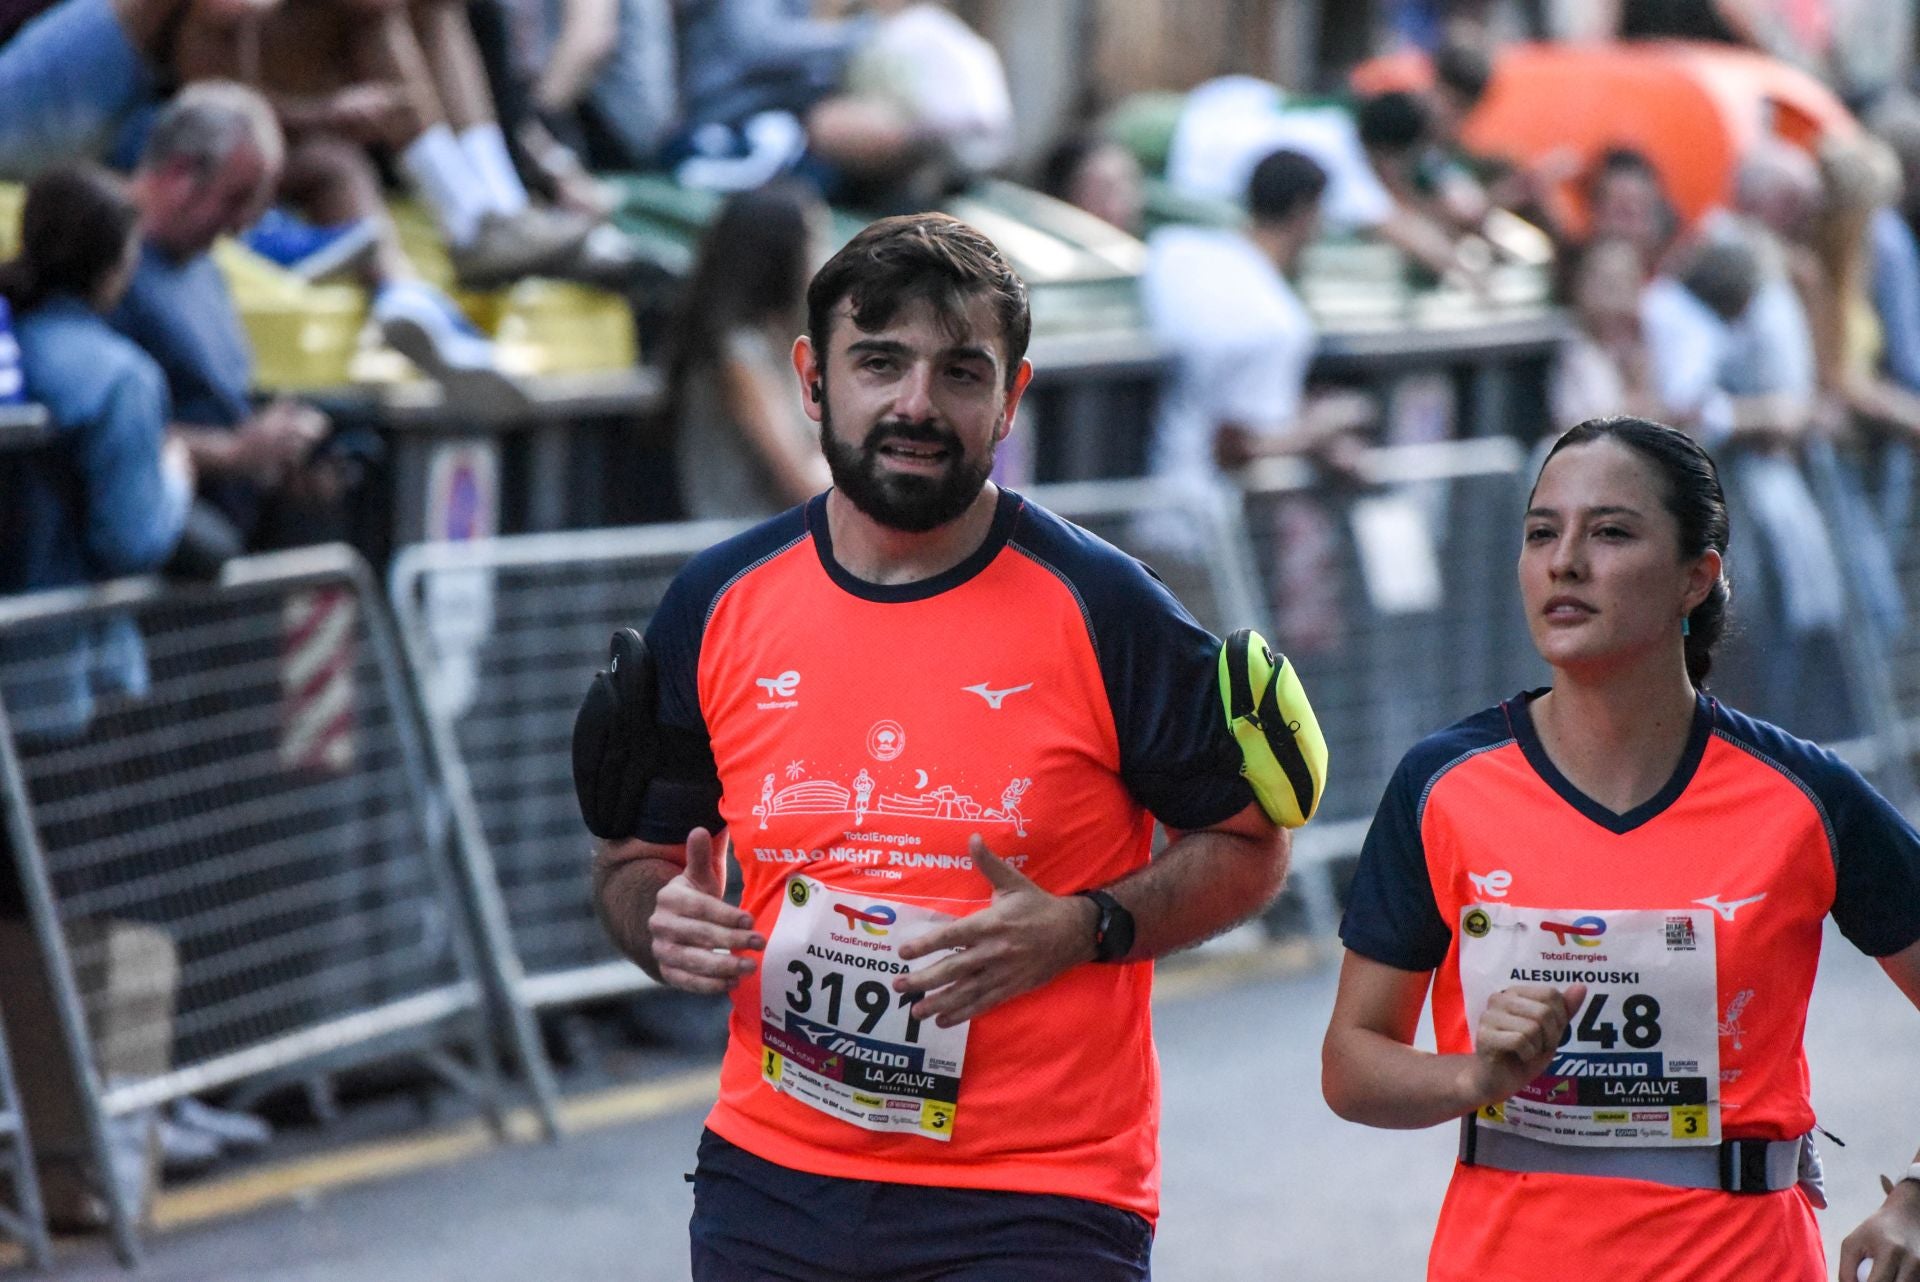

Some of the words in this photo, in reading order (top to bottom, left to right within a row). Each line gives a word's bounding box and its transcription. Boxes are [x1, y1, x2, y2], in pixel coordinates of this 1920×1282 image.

[843, 831, 922, 846] TotalEnergies
[753, 848, 825, 863] BILBAO
[829, 847, 883, 865] NIGHT
[887, 850, 973, 870] RUNNING
[864, 869, 902, 880] EDITION
[830, 932, 892, 951] TotalEnergies
[806, 944, 910, 974] ALVAROROSA
[1541, 952, 1608, 963] TotalEnergies
[1510, 968, 1640, 984] ALESUIKOUSKI
[1556, 994, 1662, 1049] 48
[865, 1067, 885, 1083] LA
[887, 1073, 936, 1089] SALVE
[1604, 1081, 1626, 1095] LA
[1628, 1081, 1680, 1095] SALVE
[932, 1112, 949, 1129] 3
[1684, 1116, 1698, 1134] 3
